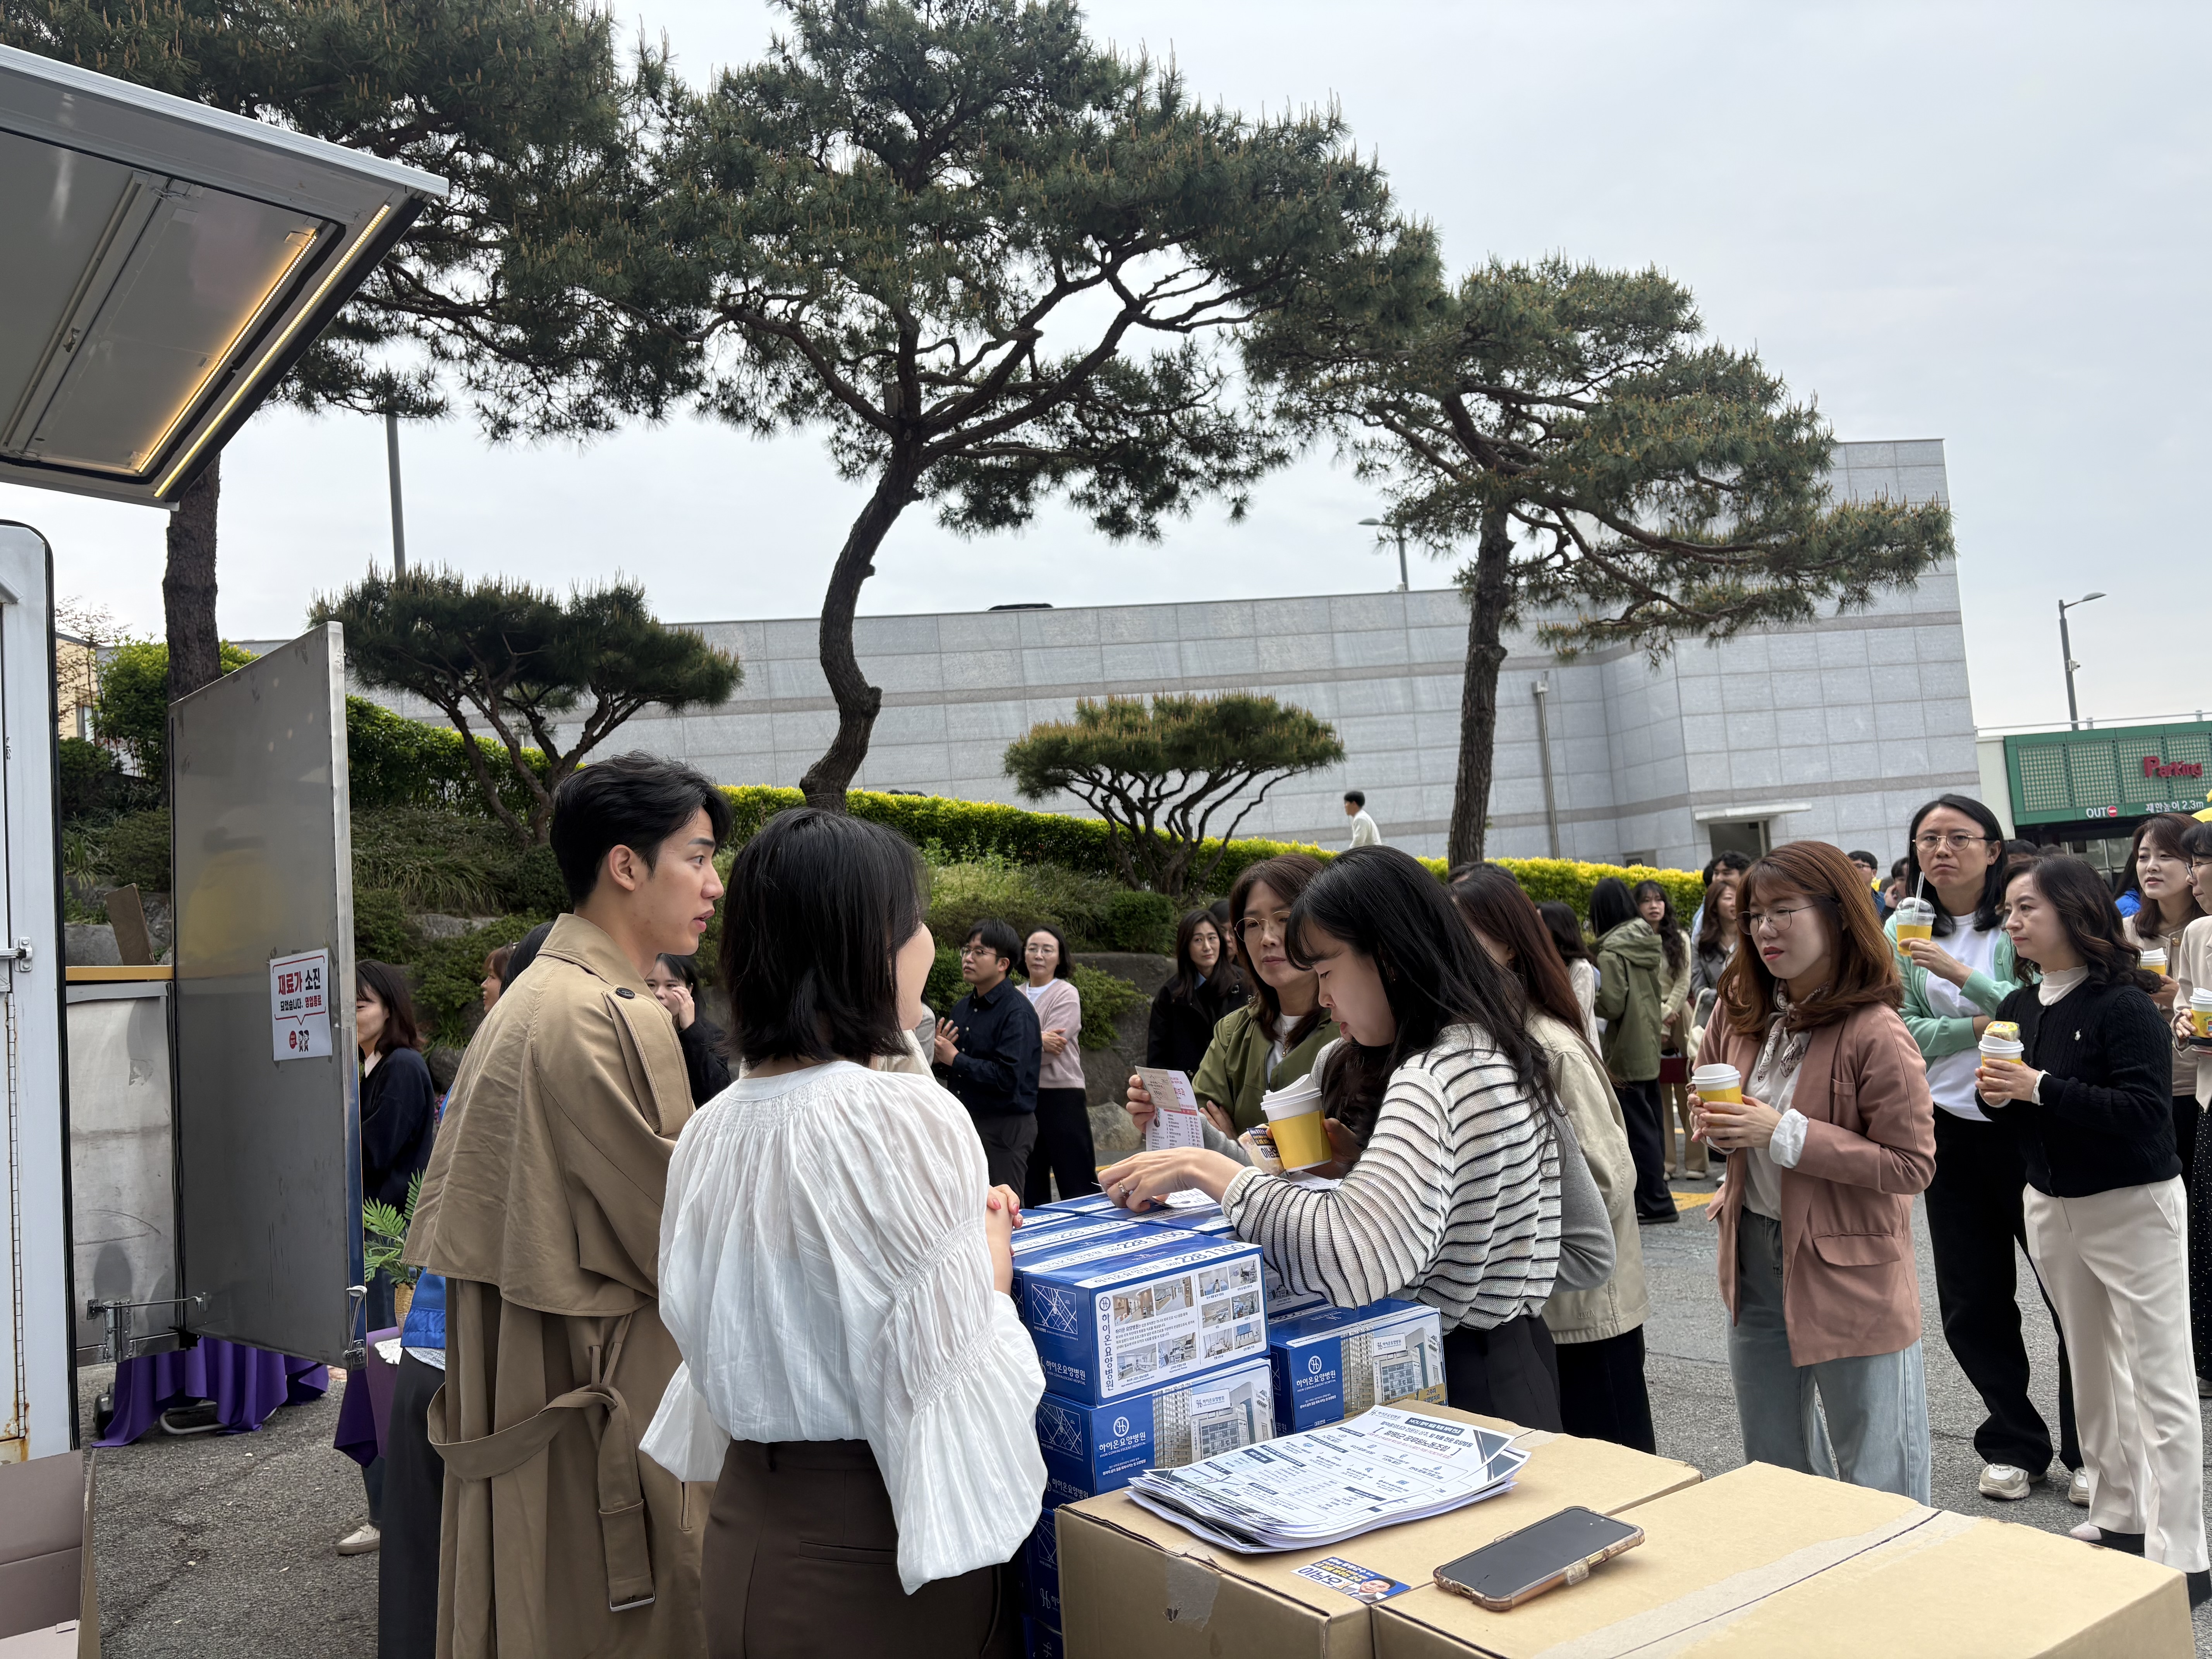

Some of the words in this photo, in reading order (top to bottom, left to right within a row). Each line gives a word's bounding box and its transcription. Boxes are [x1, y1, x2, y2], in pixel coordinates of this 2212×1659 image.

[2143, 756, 2203, 778] Parking
[2086, 807, 2107, 818] OUT
[2182, 800, 2203, 810] 2.3m
[278, 971, 302, 995] 재료가
[305, 968, 321, 991] 소진
[280, 998, 303, 1011] 되었습니다.
[305, 995, 322, 1008] 영업종료
[1117, 1231, 1185, 1249] 228.1100
[1175, 1244, 1246, 1263] 228.1100
[1102, 1313, 1114, 1391] 하이온요양병원
[1046, 1360, 1085, 1381] 하이온요양병원
[1297, 1370, 1336, 1388] 하이온요양병원
[1099, 1431, 1146, 1452] 하이온요양병원
[1403, 1435, 1451, 1452] 공무원노동조합
[1298, 1567, 1343, 1586] 이남오
